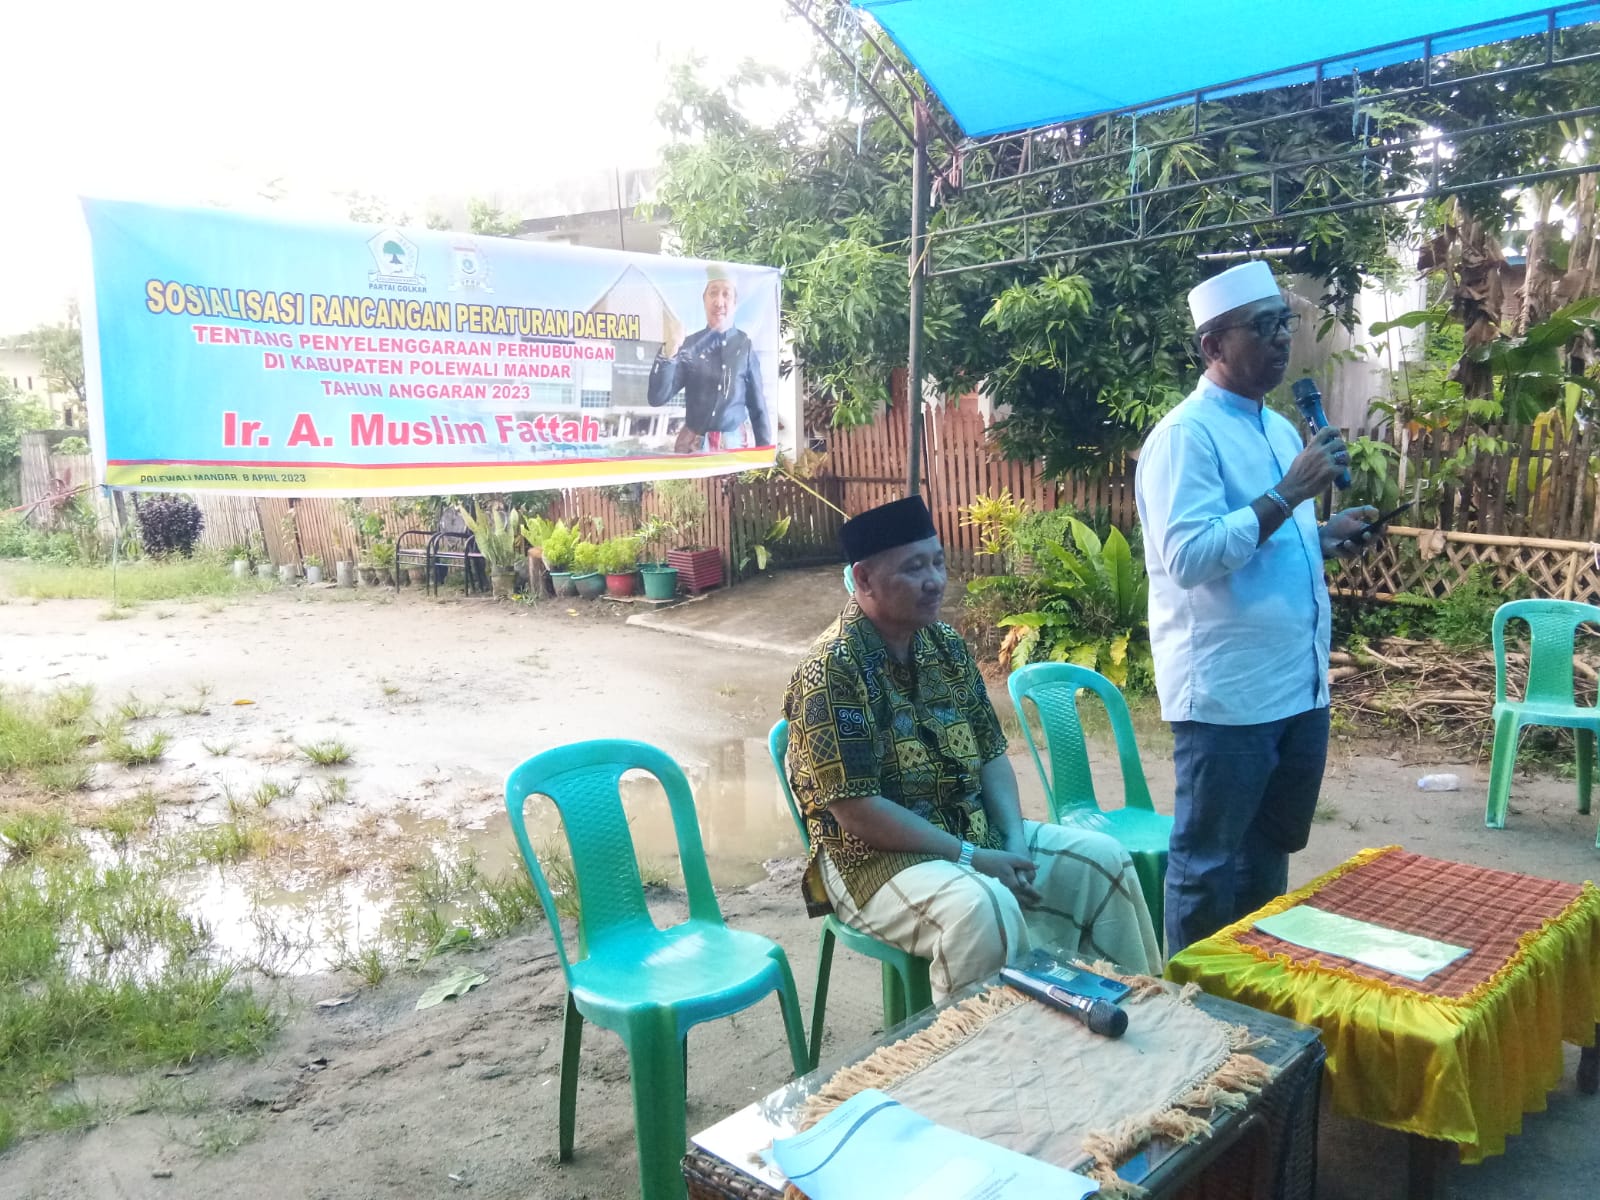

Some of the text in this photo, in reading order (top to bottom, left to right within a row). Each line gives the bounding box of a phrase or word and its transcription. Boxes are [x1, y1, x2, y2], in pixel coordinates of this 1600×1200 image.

[146, 279, 640, 340] SOSIALISASI RANCANGAN PERATURAN DAERAH
[193, 325, 615, 360] TENTANG PENYELENGGARAAN PERHUBUNGAN
[264, 353, 571, 378] DI KABUPATEN POLEWALI MANDAR
[321, 380, 531, 400] TAHUN ANGGARAN 2023
[223, 412, 599, 447] Ir. A. Muslim Fattah
[140, 474, 192, 484] POLEWALI
[252, 474, 279, 483] APRIL
[281, 474, 307, 483] 2023
